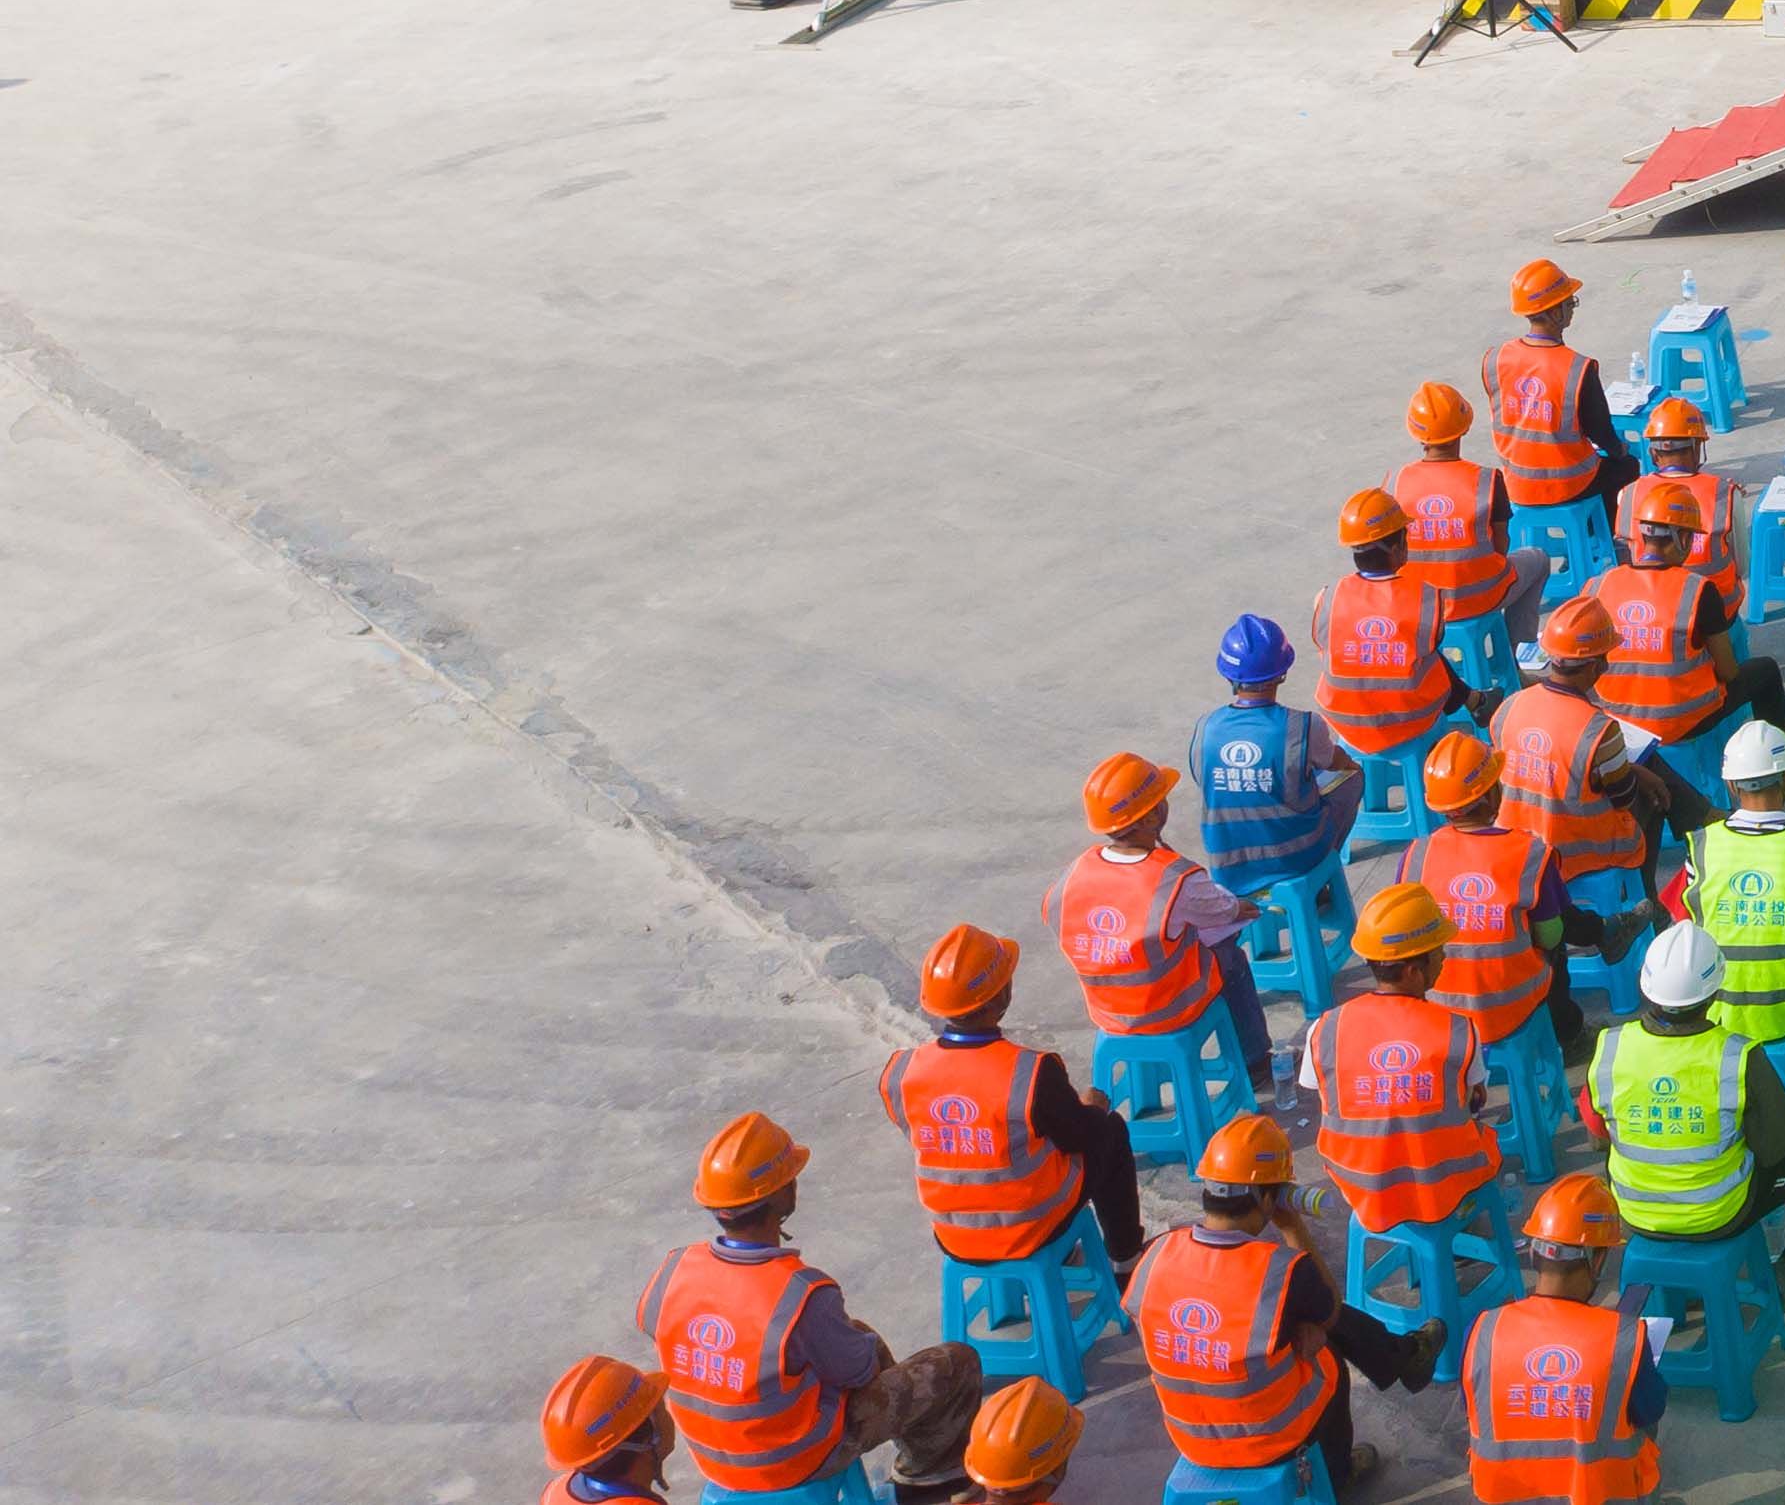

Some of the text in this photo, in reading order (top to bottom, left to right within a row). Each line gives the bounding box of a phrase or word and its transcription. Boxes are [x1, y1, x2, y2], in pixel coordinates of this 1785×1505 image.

[1213, 766, 1273, 786] 云南建投
[1214, 778, 1273, 794] 二建公司
[1627, 1104, 1704, 1121] 云南建投
[1628, 1118, 1704, 1135] 二建公司
[1508, 1383, 1593, 1405] 云南建投
